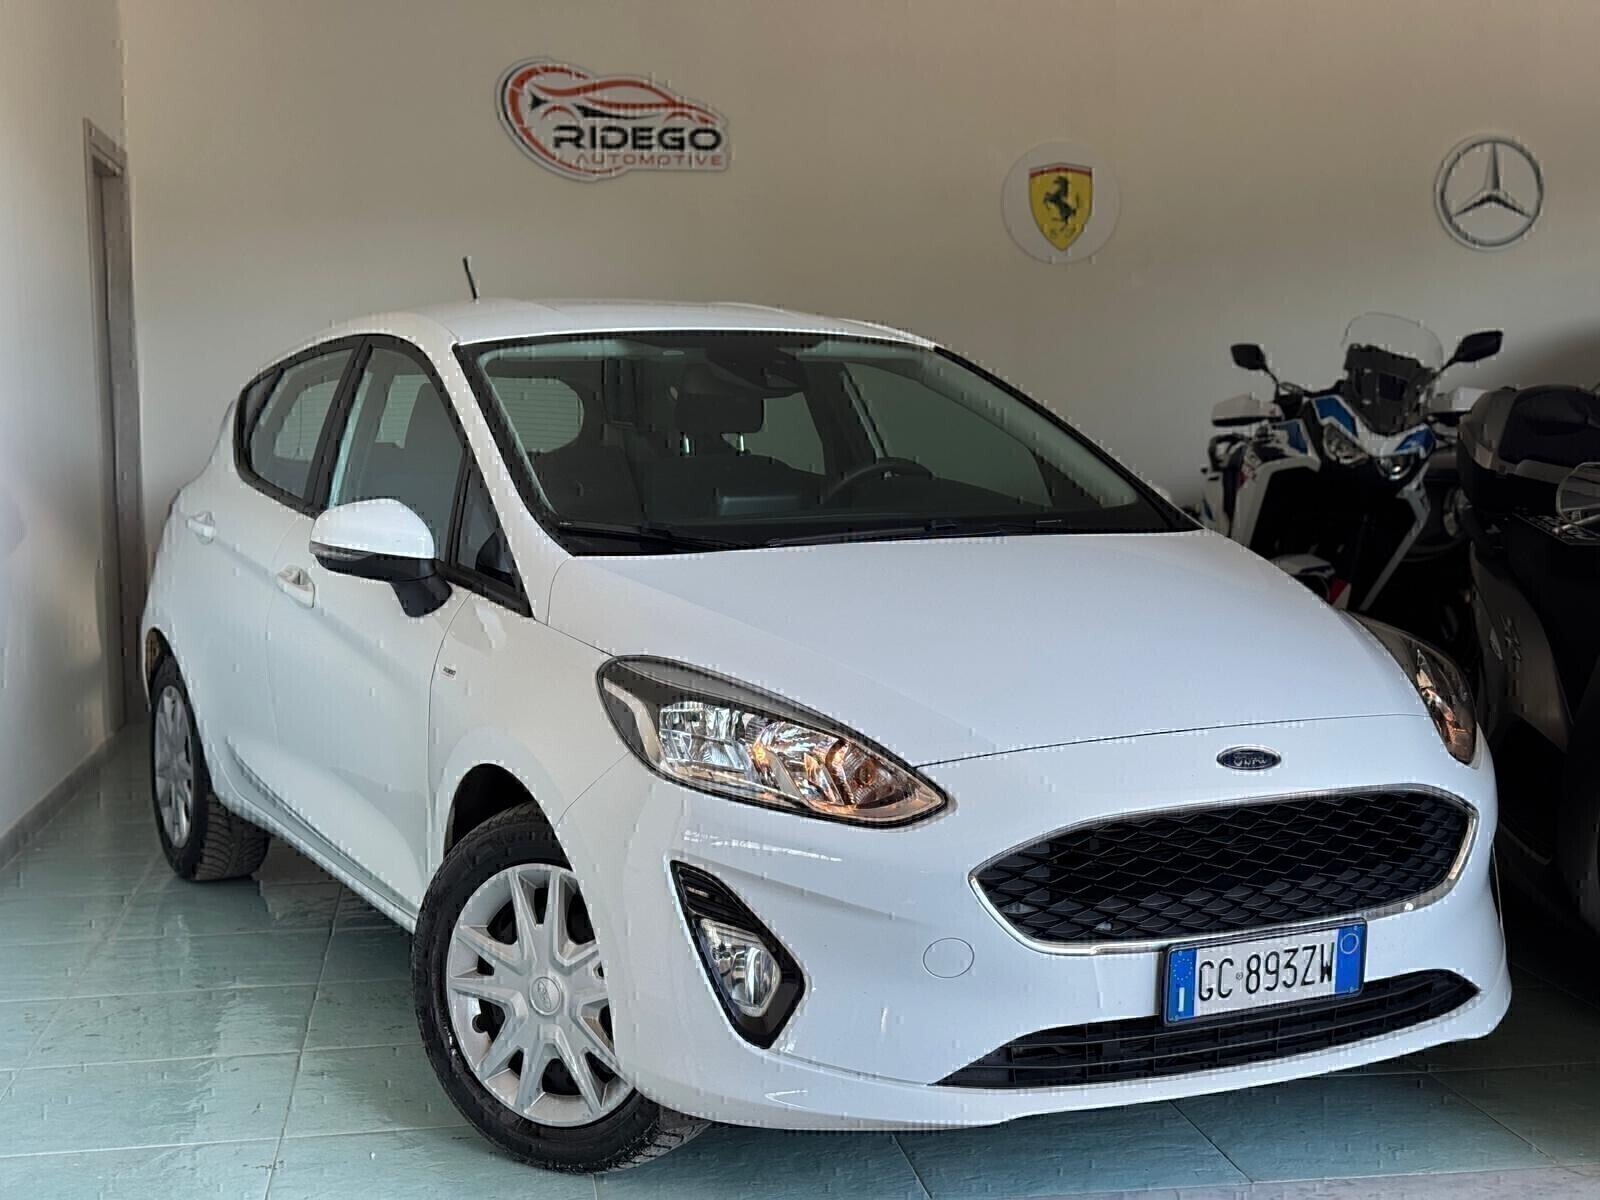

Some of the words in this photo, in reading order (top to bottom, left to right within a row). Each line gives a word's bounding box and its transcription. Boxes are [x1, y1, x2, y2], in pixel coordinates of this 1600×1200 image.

[553, 125, 722, 151] RIDEGO
[576, 153, 723, 166] AUTOMOTIVE
[1198, 958, 1235, 1001] GC
[1245, 942, 1336, 994] 893ZW
